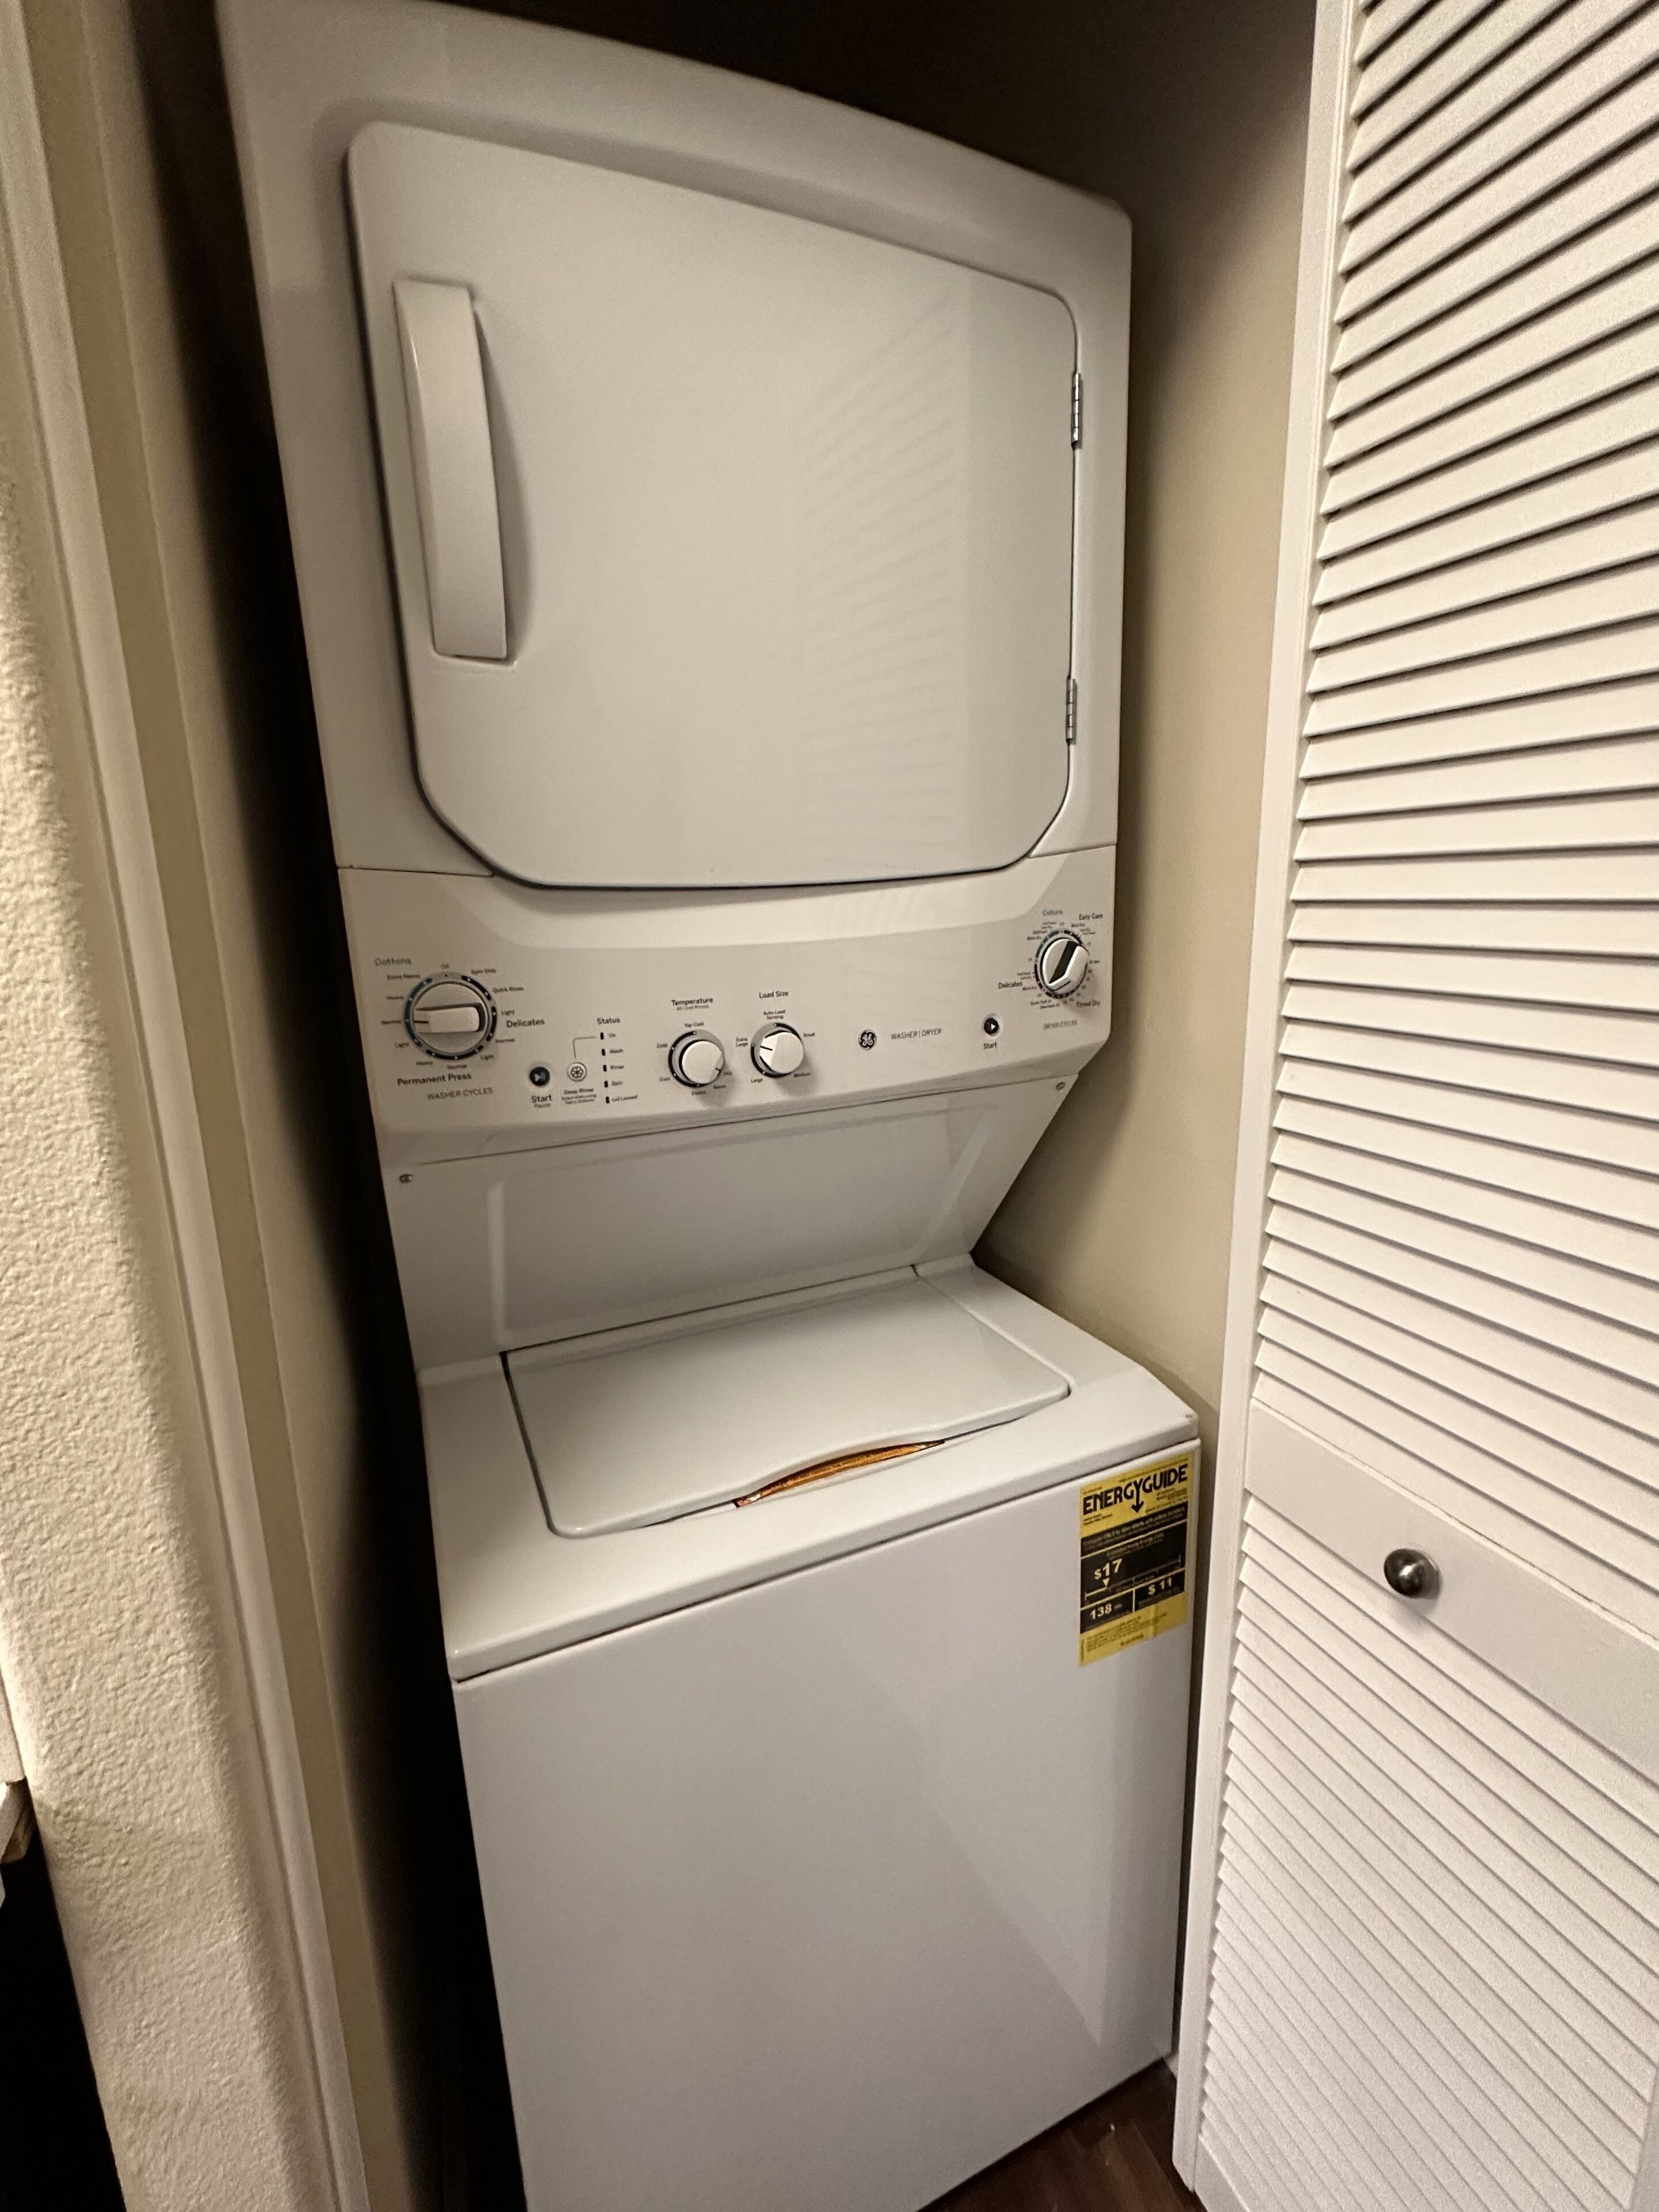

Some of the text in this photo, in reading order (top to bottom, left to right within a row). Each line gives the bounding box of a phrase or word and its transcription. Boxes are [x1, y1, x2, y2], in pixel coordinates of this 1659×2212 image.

[374, 957, 412, 967] Cottons
[671, 998, 713, 1006] Temperature
[506, 1018, 545, 1028] Delicates
[397, 1072, 472, 1086] Permanent Press
[427, 1086, 494, 1101] WASHER CYCLES
[531, 1094, 552, 1104] Start
[1083, 1463, 1188, 1516] ENERGYGUIDE
[1090, 1603, 1112, 1620] 138
